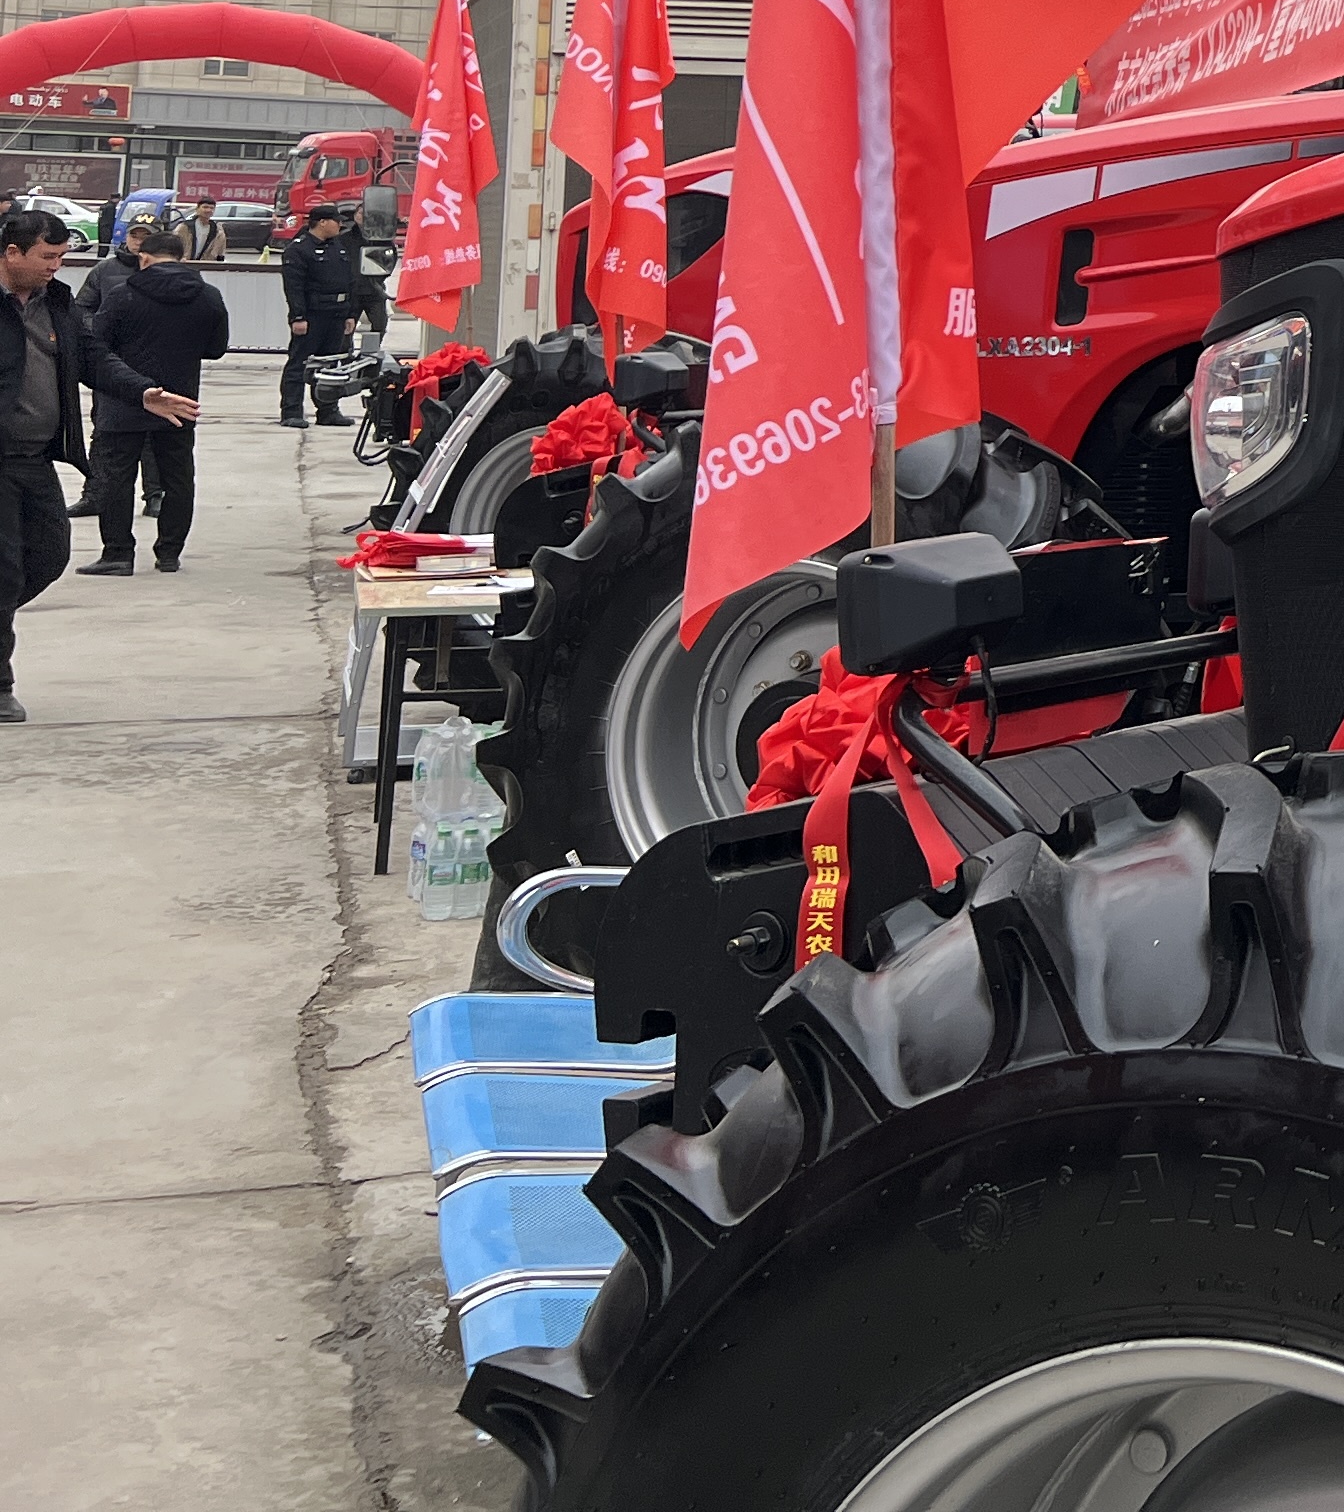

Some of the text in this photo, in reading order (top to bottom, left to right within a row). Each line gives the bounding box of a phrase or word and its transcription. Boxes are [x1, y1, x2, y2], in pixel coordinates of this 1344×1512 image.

[804, 844, 841, 965] 和田瑞天农
